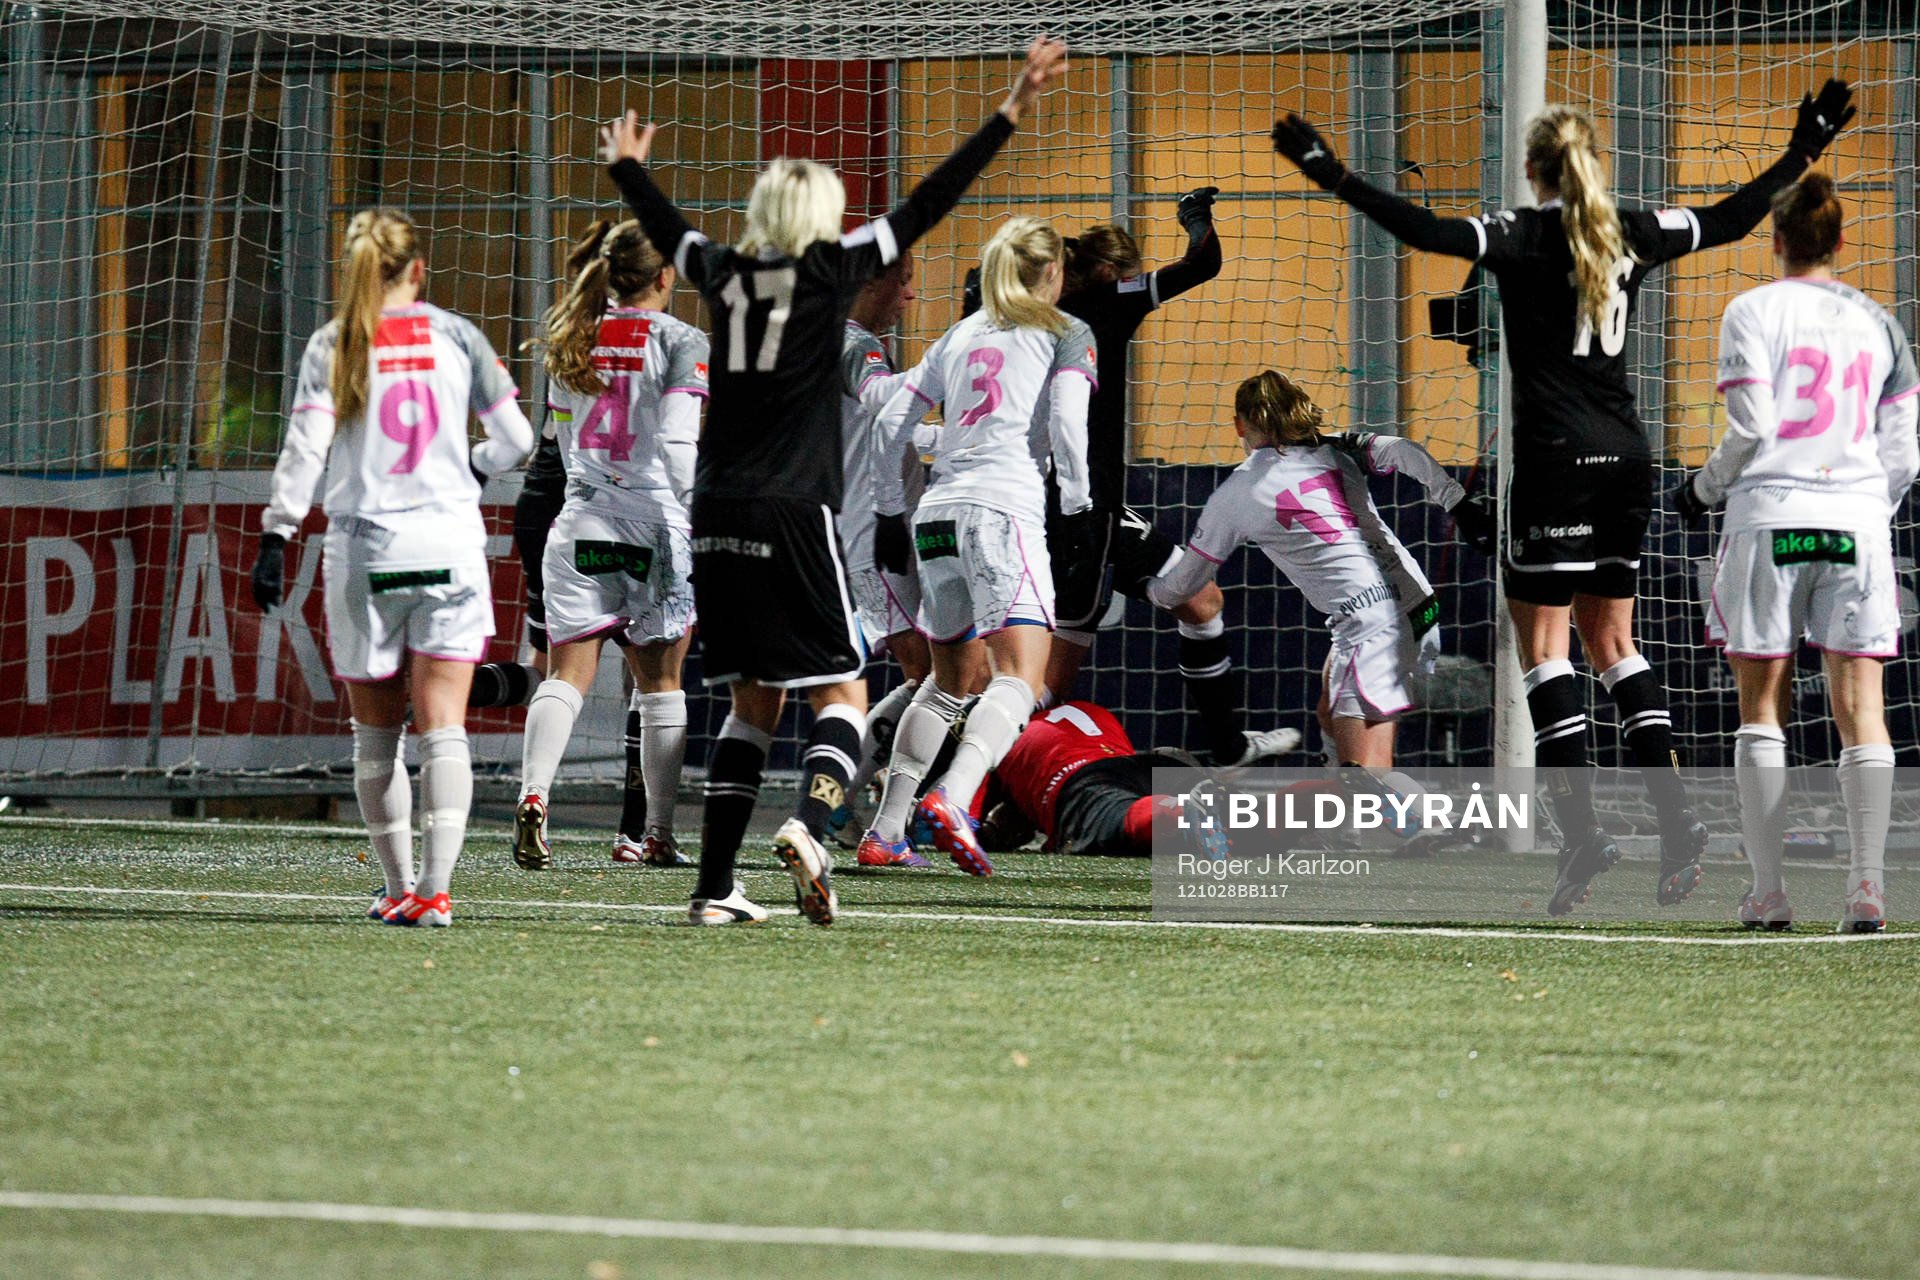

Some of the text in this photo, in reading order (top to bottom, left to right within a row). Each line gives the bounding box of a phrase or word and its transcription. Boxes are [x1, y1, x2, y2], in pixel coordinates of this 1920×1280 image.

[720, 267, 797, 373] 17
[379, 379, 440, 475] 9
[578, 375, 637, 462] 4
[958, 346, 1004, 427] 3
[1777, 346, 1873, 443] 31
[1275, 468, 1360, 545] 17
